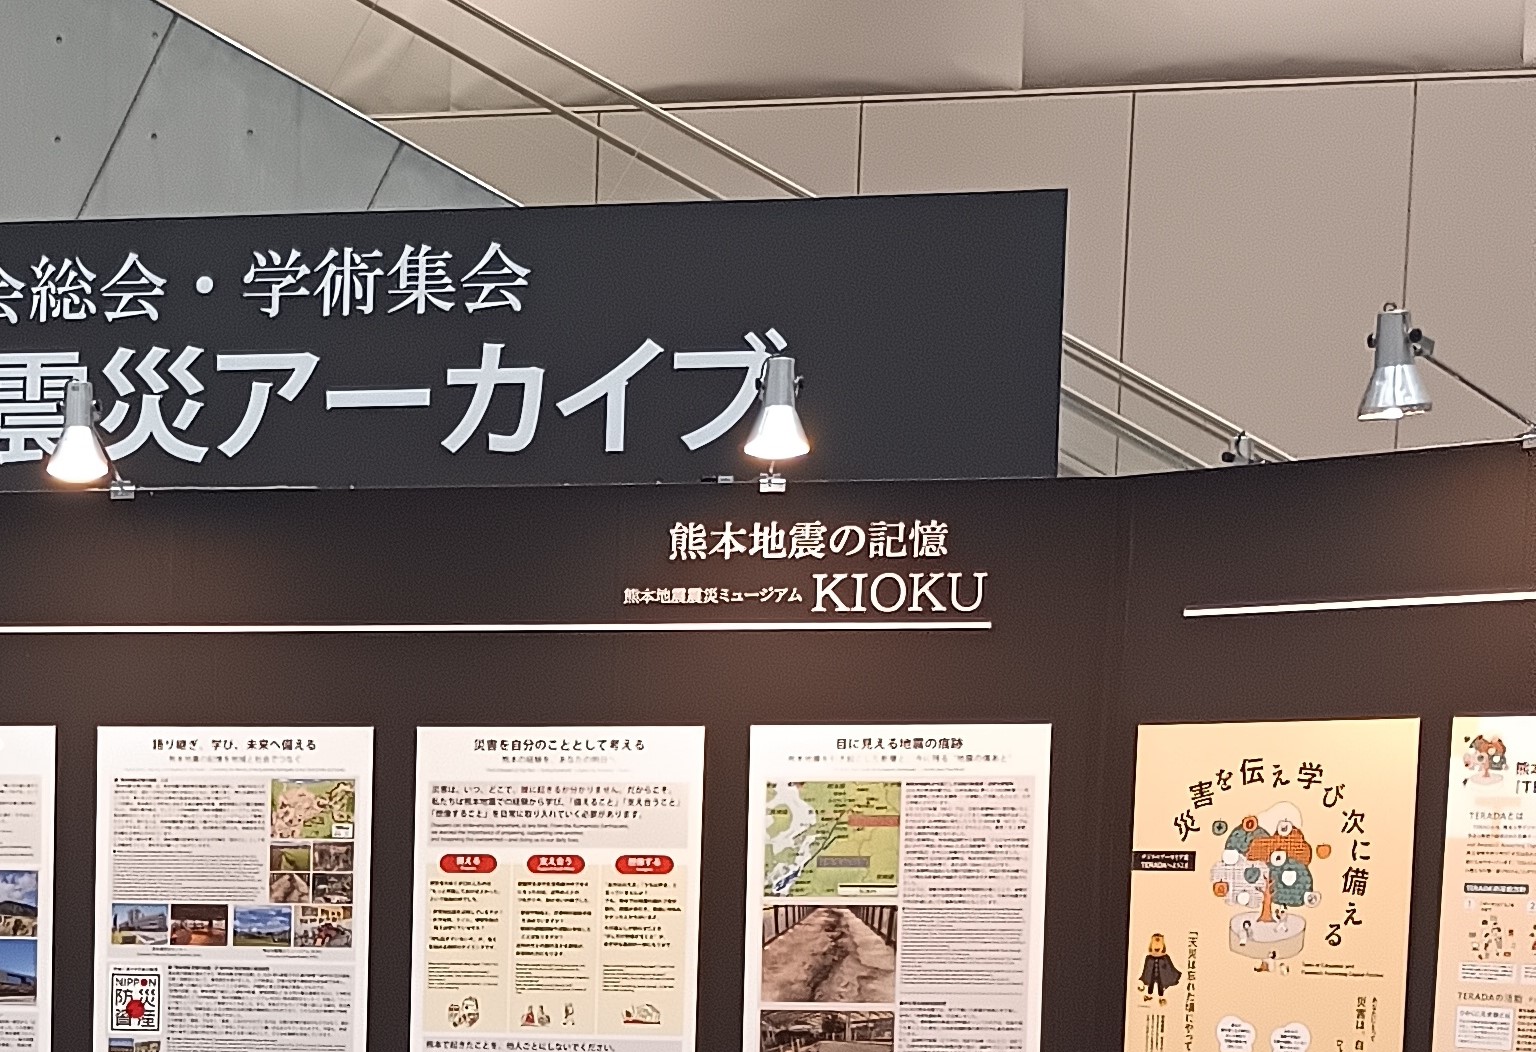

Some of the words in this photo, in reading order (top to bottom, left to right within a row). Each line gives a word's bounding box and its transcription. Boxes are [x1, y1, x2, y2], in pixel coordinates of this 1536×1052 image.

[668, 519, 950, 561] 熊本地震の記憶
[622, 586, 804, 605] 熊本地震震災ミュージアム
[810, 571, 989, 613] KIOKU
[473, 738, 646, 752] 災害を自分のこととして考える
